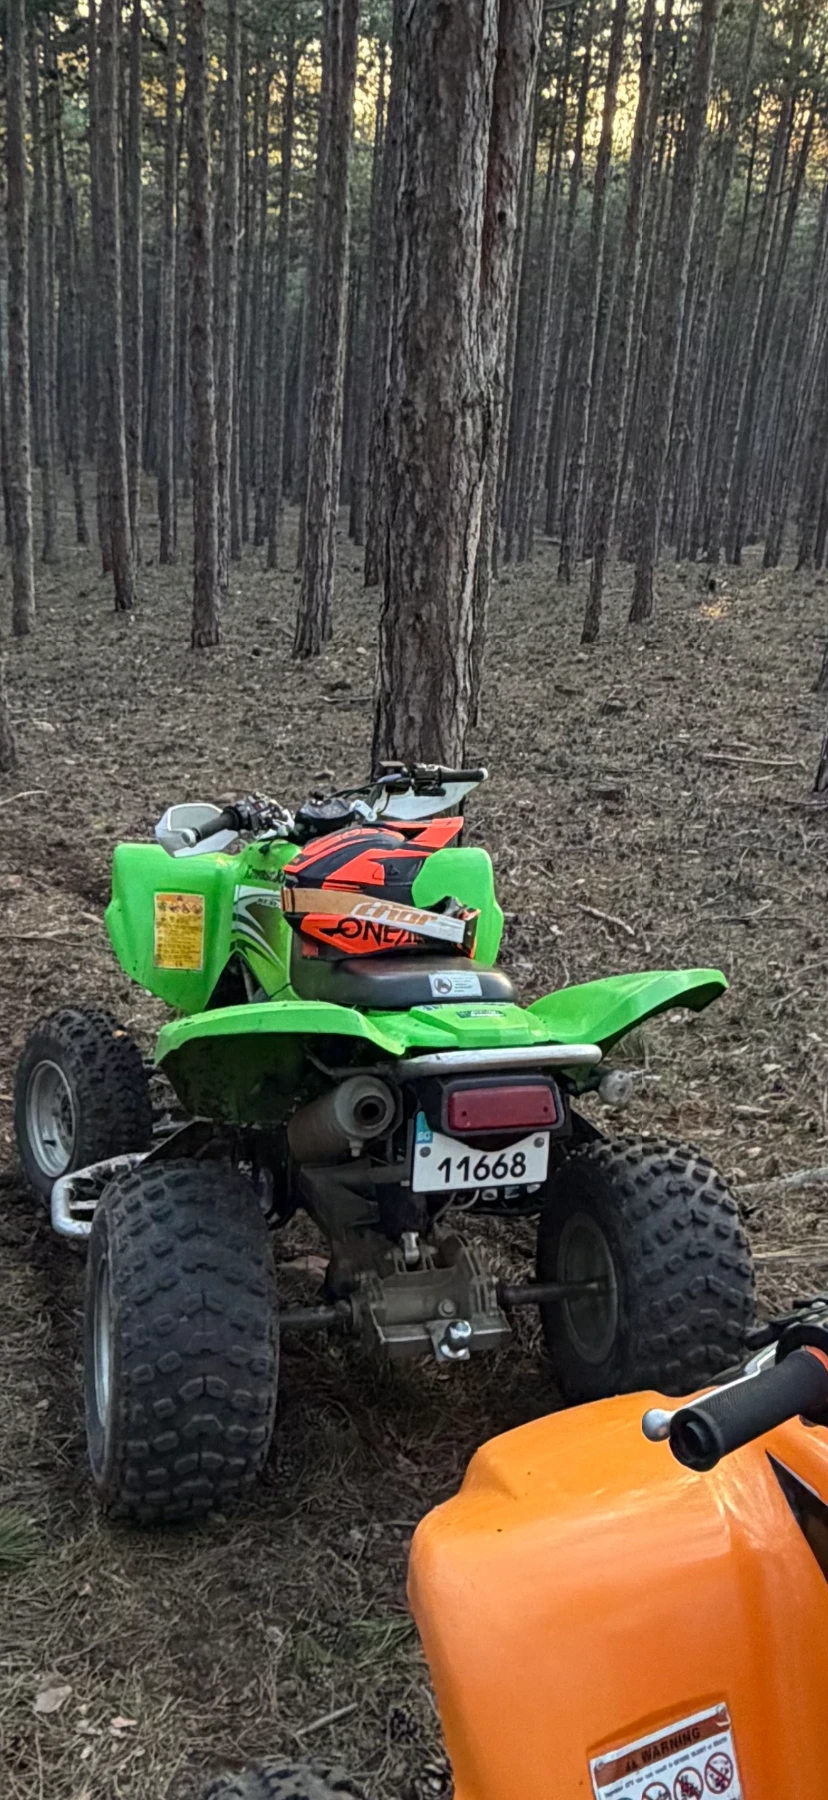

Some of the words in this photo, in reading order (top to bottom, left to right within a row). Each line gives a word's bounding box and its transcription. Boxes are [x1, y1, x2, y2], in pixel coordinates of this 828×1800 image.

[416, 1131, 430, 1141] BG
[437, 1152, 526, 1183] 11668
[641, 1727, 701, 1761] WARNING
